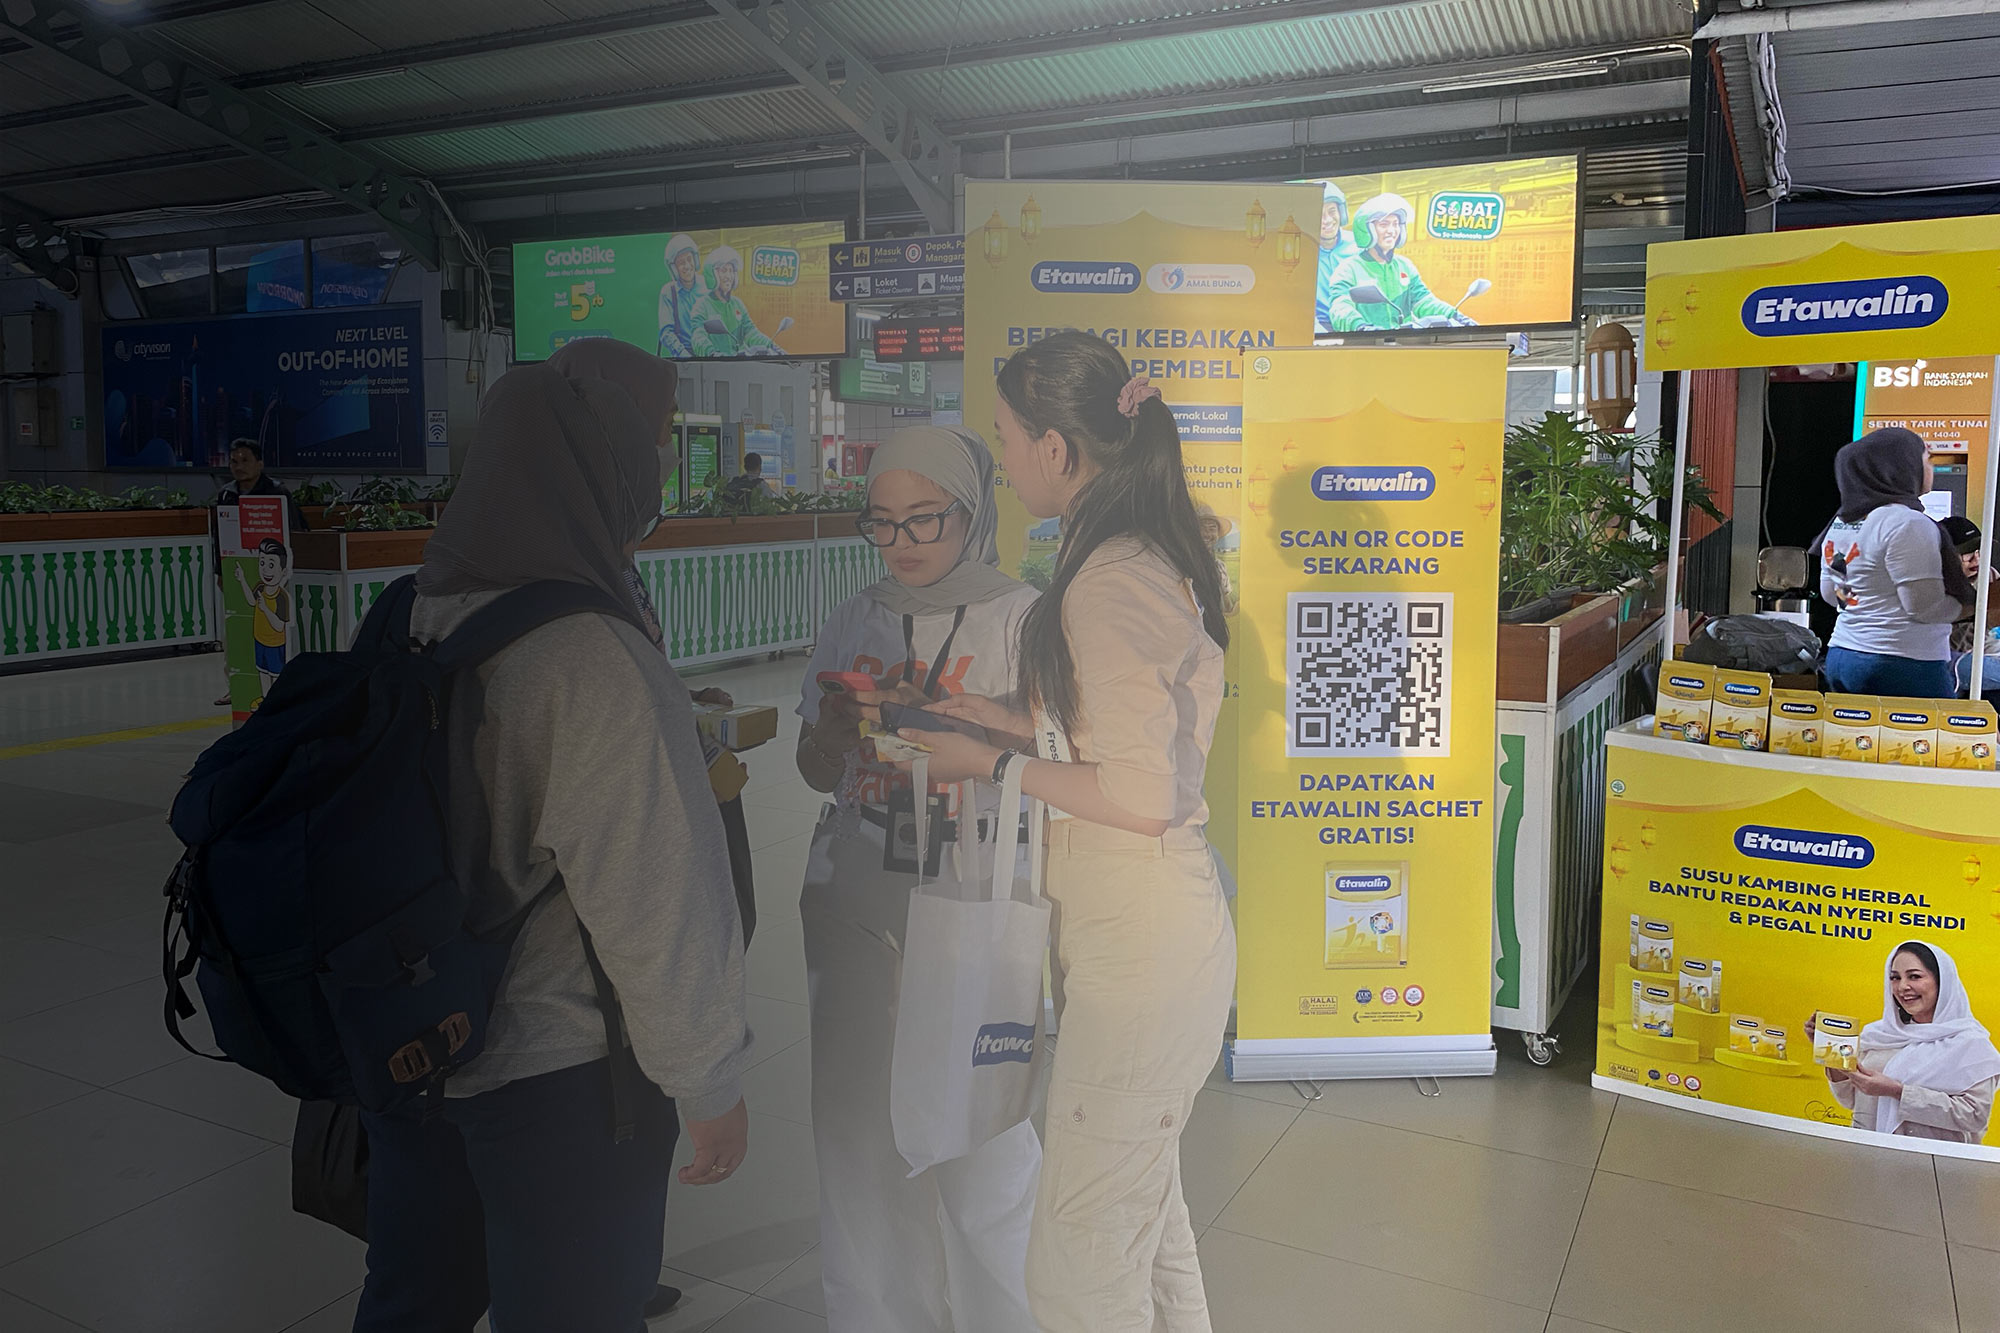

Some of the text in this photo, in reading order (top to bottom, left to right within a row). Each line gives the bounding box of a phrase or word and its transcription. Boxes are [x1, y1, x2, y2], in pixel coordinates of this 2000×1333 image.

[1433, 214, 1497, 230] HEMAT
[874, 246, 902, 256] Masuk
[925, 242, 954, 252] Depok,
[545, 245, 616, 266] GrabBike
[756, 264, 796, 277] HEMAT
[1037, 266, 1134, 286] Etawalin
[875, 277, 898, 287] Loket
[892, 286, 913, 294] Counter
[1186, 280, 1243, 288] AMAL BUNDA
[570, 284, 591, 322] 5
[1754, 286, 1934, 324] Etawalin
[335, 326, 409, 343] NEXT LEVEL
[1136, 328, 1275, 348] KEBAIKAN
[134, 343, 171, 358] cityvision
[278, 346, 409, 372] OUT-OF-HOME
[1132, 359, 1244, 379] PEMBEL
[1873, 364, 1921, 387] BSI
[1950, 371, 1988, 379] SYARIAH
[1924, 378, 1974, 386] INDONESIA
[1172, 411, 1229, 421] ernak Lokal
[1177, 424, 1242, 434] an Ramadan
[1868, 420, 1988, 429] SETOR TARIK TUNAI
[1184, 464, 1207, 474] ntu
[1188, 479, 1233, 489] utuhan
[1319, 470, 1427, 493] Etawalin
[1281, 530, 1463, 549] SCAN QR CODE
[1304, 557, 1438, 575] SEKARANG
[1671, 678, 1704, 688] Etawalin
[1726, 685, 1760, 694] Etawalin
[1783, 704, 1816, 713] Etawalin
[1835, 710, 1870, 720] Etawalin
[1891, 714, 1927, 723] Etawalin
[1950, 718, 1987, 726] Etawalin
[1046, 731, 1062, 763] Fres
[1299, 773, 1434, 791] DAPATKAN
[1251, 800, 1482, 818] ETAWALIN SACHET
[1318, 826, 1415, 845] GRATIS!
[1742, 831, 1866, 860] Etawalin
[1338, 877, 1388, 888] Etawalin
[1680, 867, 1931, 908] SUSU KAMBING HERBAL
[1649, 881, 1966, 931] BANTU REDAKAN NYERI SENDI
[1729, 911, 1872, 941] & PEGAL LINU
